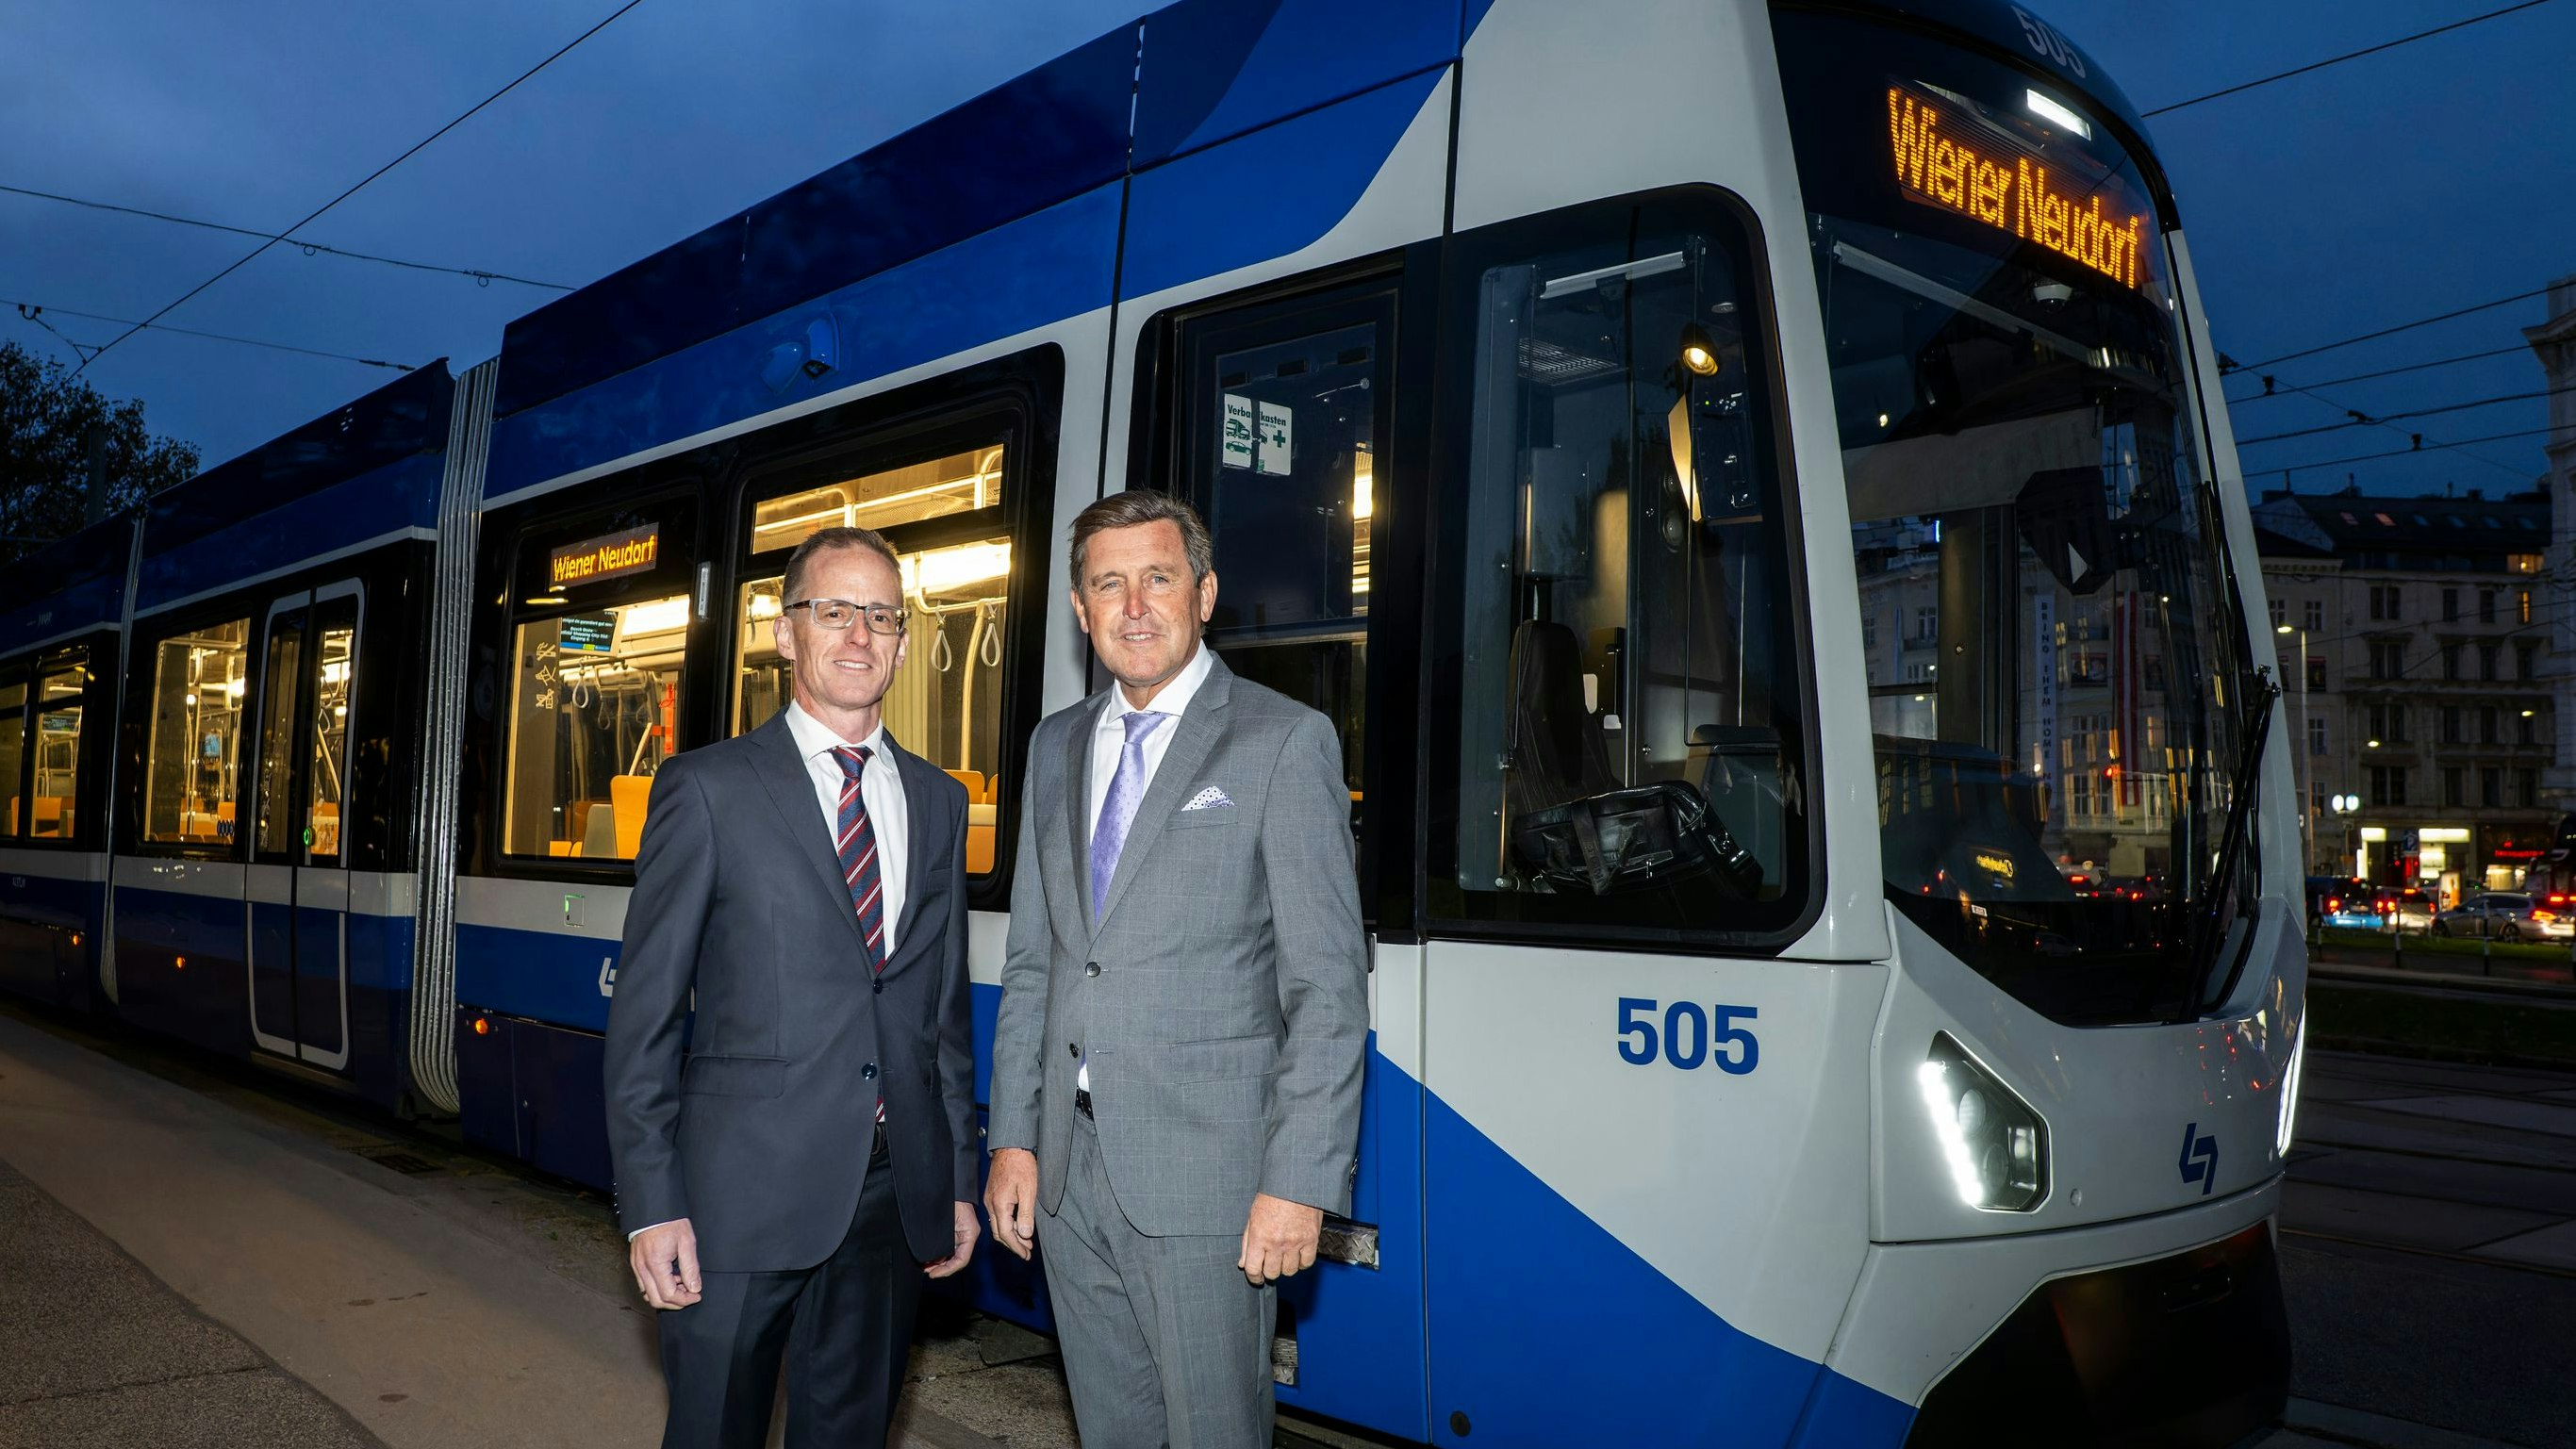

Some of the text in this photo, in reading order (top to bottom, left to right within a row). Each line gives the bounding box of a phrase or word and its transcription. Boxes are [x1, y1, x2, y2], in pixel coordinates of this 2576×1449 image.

[2010, 5, 2086, 79] 505
[1889, 88, 2138, 289] Wiener Neudorf
[1228, 403, 1287, 426] Verbakasten
[553, 535, 655, 583] Wiener Neudorf
[1617, 996, 1759, 1076] 505
